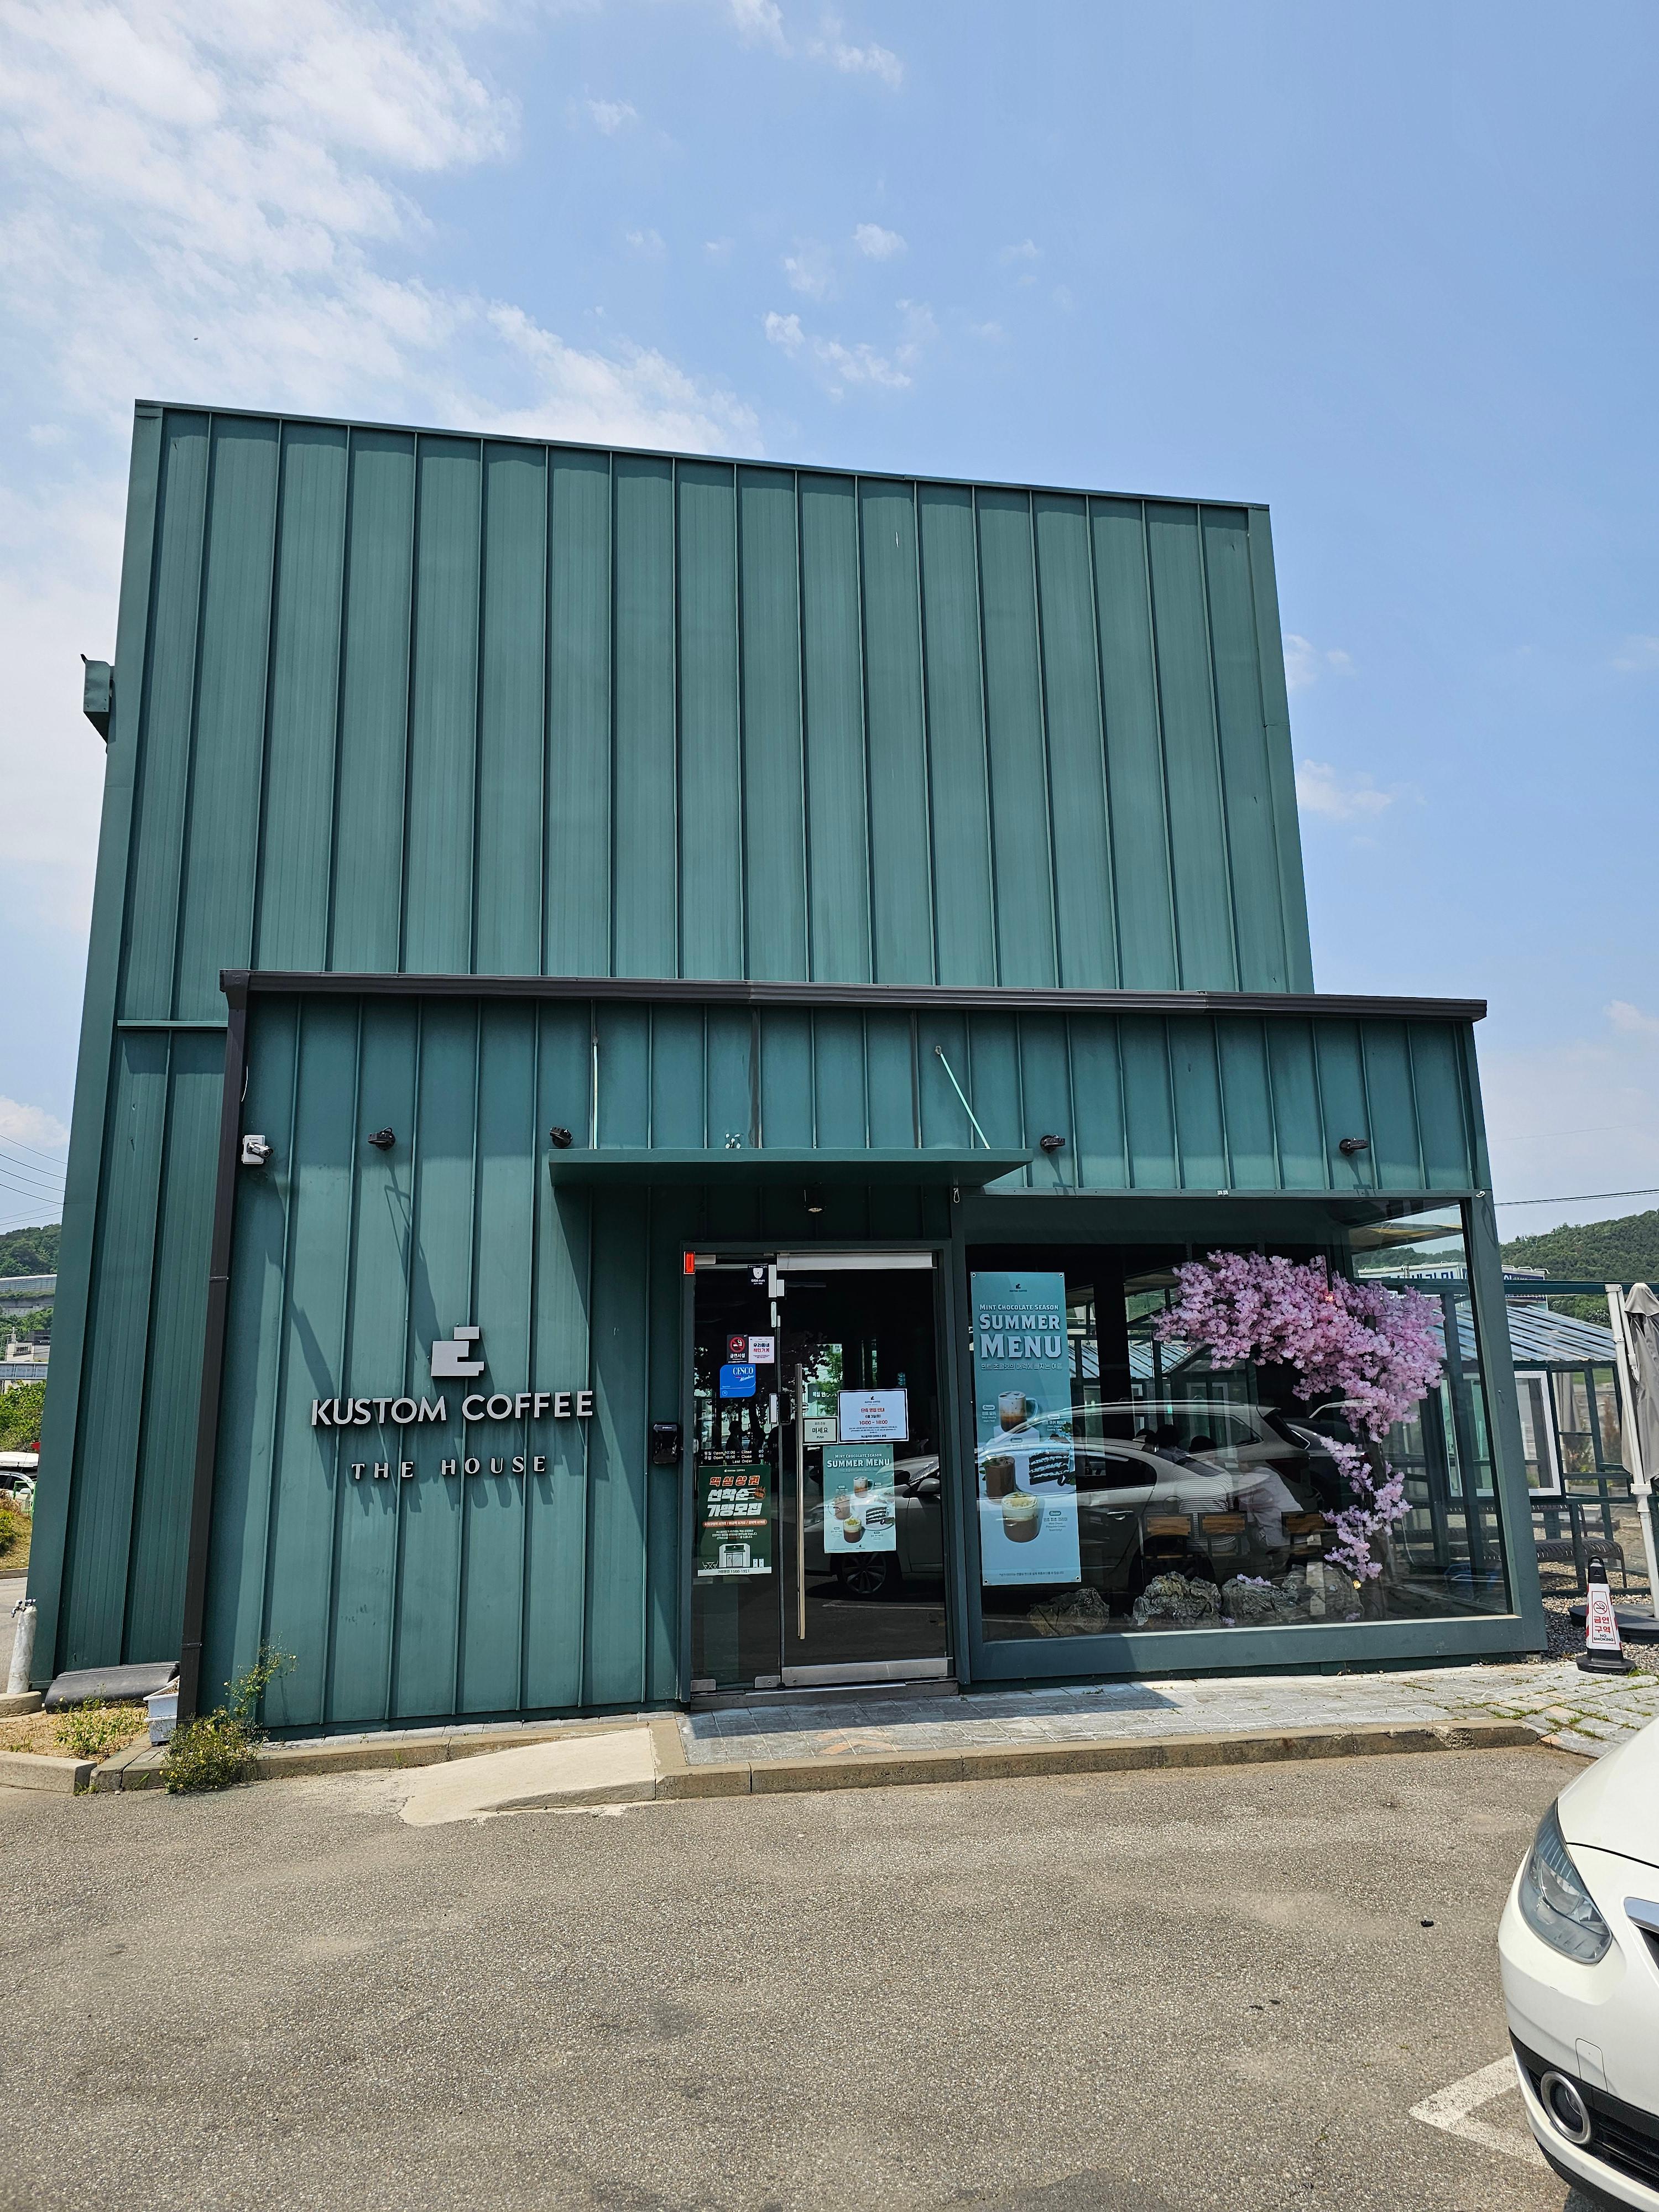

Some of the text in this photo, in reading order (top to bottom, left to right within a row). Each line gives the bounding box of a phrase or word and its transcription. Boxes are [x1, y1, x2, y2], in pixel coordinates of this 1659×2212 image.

[979, 1313, 1061, 1329] SUMMER
[980, 1333, 1062, 1358] MENU
[733, 1366, 754, 1375] CESCO
[311, 1390, 593, 1426] KUSTOM COFFEE
[351, 1455, 546, 1479] THE HOUSE
[827, 1458, 890, 1468] SUMMER MENU
[707, 1488, 754, 1502] 선착순
[707, 1503, 763, 1517] 가맹모집
[1594, 1616, 1610, 1624] 금연
